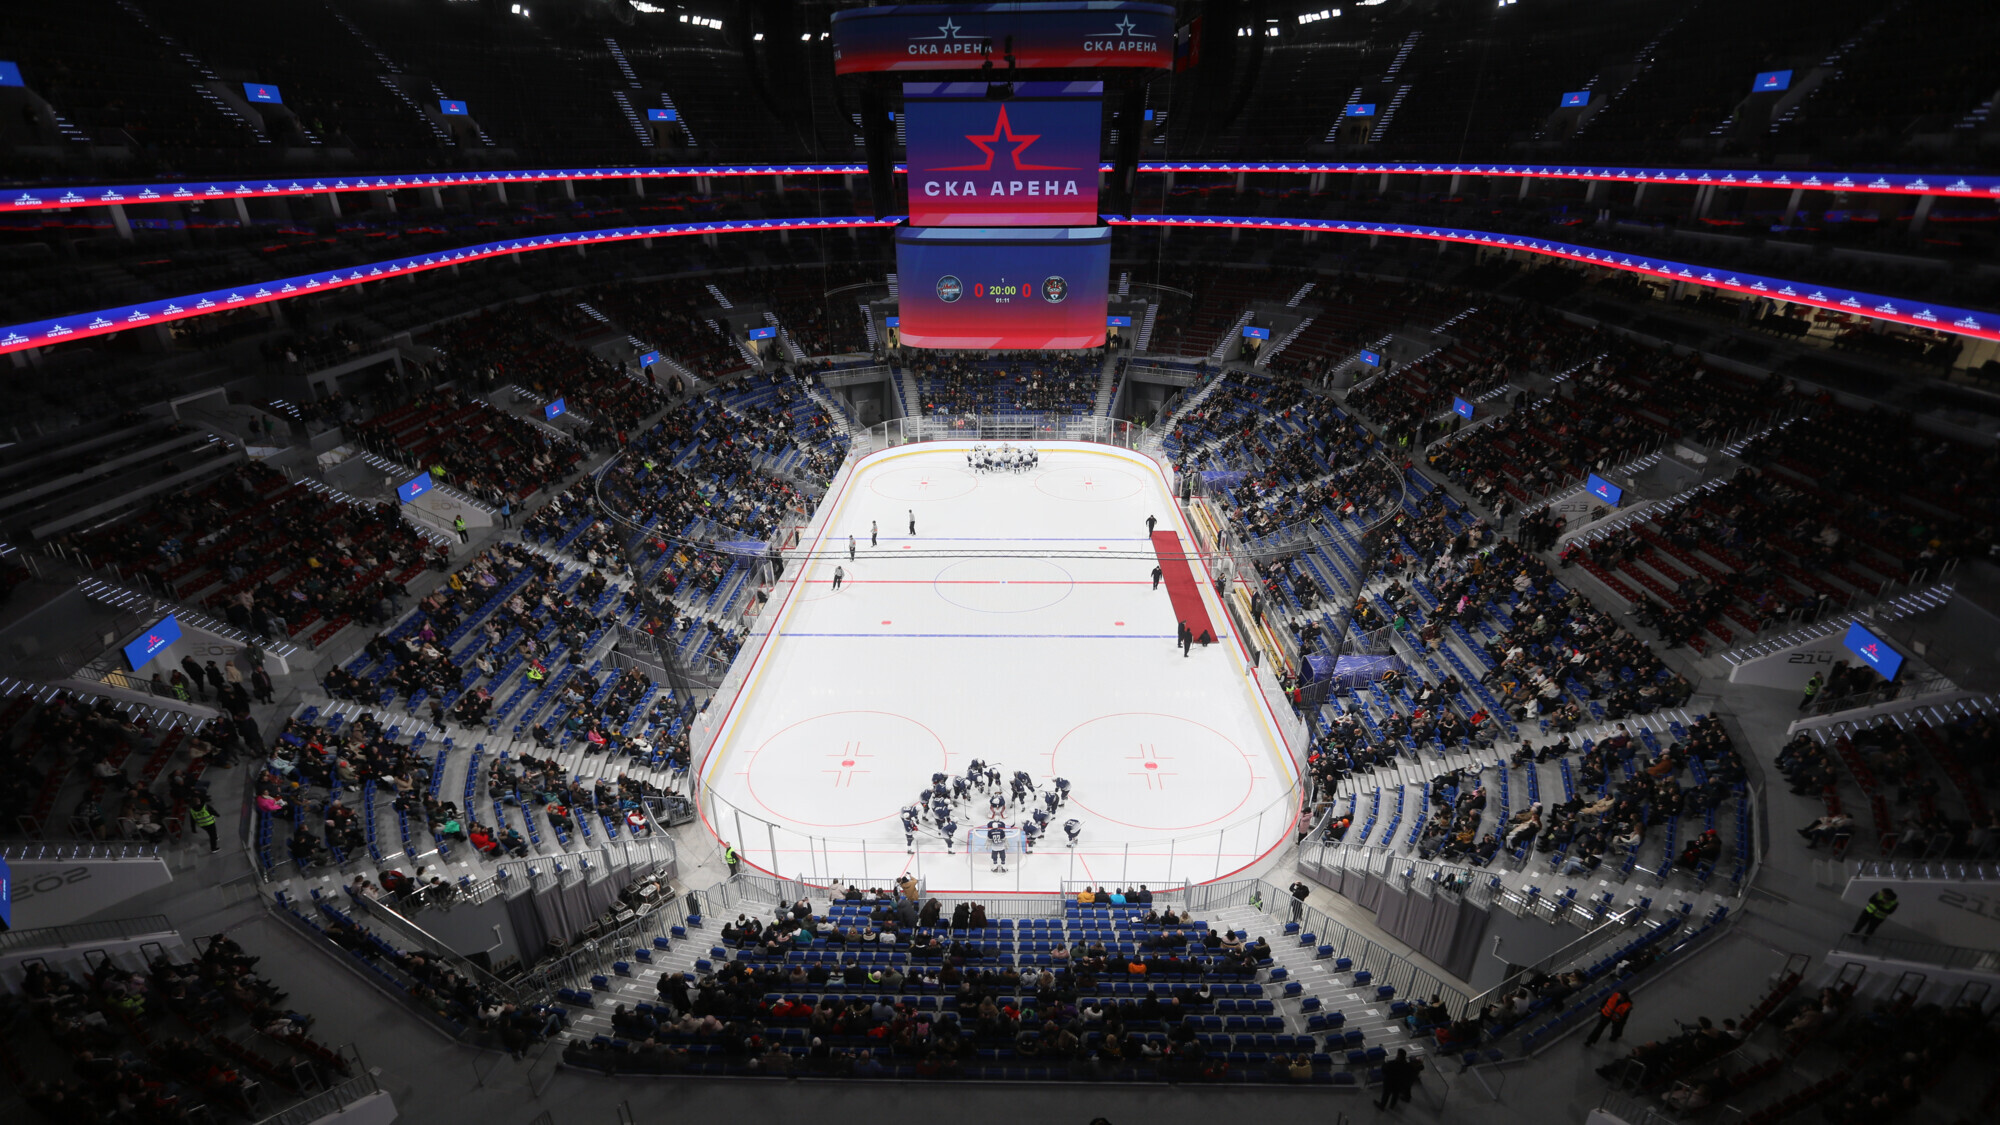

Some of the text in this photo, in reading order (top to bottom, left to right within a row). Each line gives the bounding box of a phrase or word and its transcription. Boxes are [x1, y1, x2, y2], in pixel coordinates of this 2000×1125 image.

[908, 44, 938, 55] СКА
[1083, 41, 1157, 52] СКА АРЕНА
[924, 180, 1079, 197] СКА АРЕНА
[974, 283, 1031, 298] 0 20:00 0
[193, 646, 238, 656] 203
[1788, 653, 1833, 665] 214
[10, 867, 92, 904] 202
